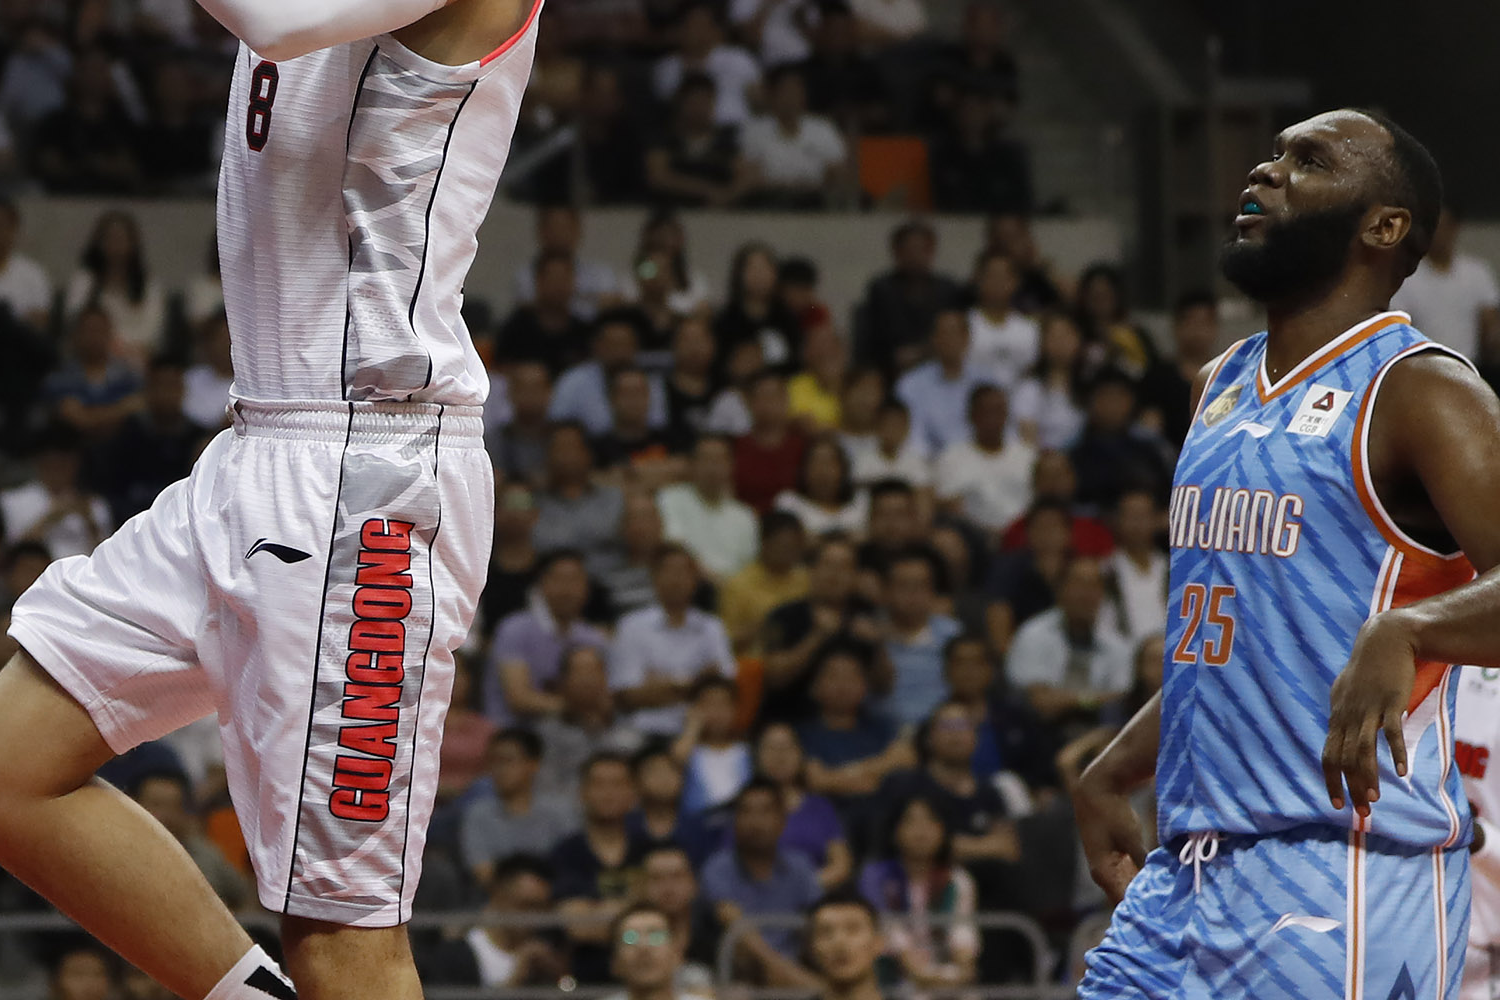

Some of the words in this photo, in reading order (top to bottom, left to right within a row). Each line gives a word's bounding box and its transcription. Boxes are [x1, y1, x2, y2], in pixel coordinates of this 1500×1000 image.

[245, 59, 280, 153] 8
[1299, 424, 1319, 434] CGB
[1172, 583, 1237, 666] 25
[328, 517, 416, 823] GUANGDONG
[1455, 740, 1490, 779] NG
